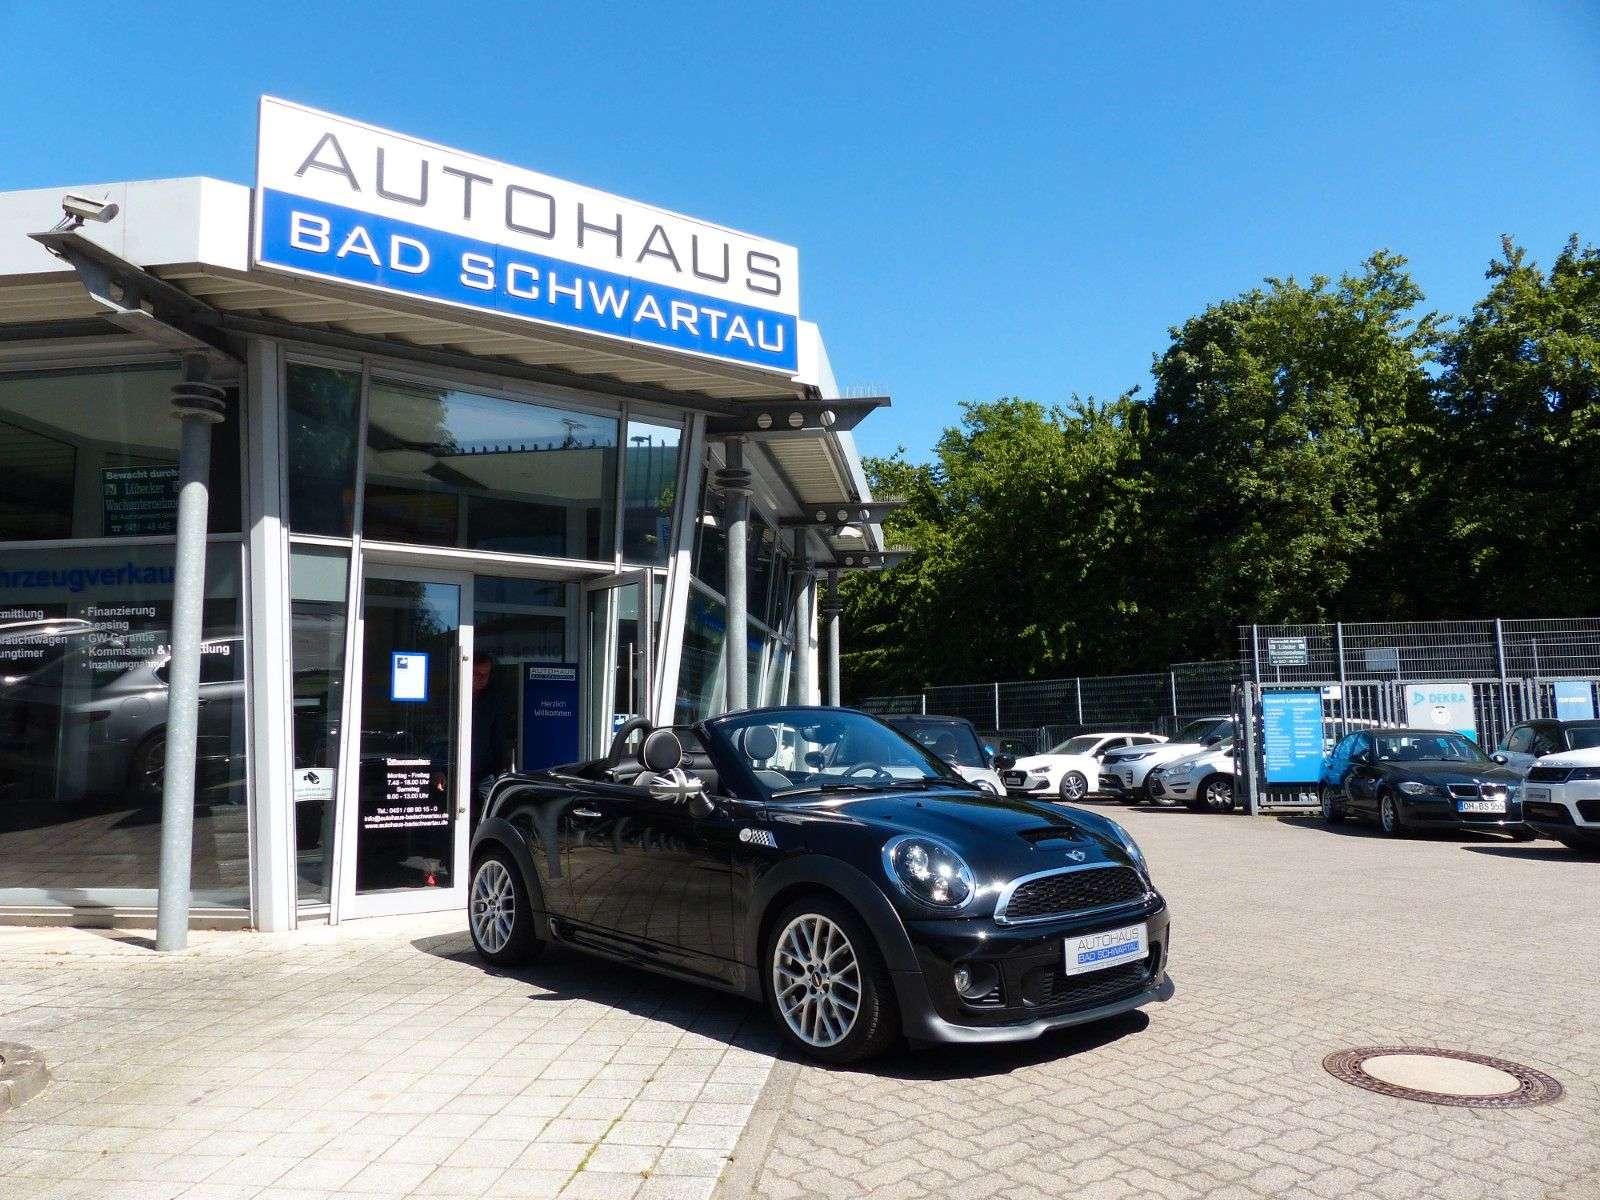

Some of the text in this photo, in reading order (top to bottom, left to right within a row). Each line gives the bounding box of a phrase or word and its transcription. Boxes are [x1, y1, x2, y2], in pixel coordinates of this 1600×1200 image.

[294, 132, 782, 297] AUTOHAUS
[290, 210, 784, 353] BAD SCHWARTAU
[88, 605, 156, 617] Finanzierung
[88, 619, 130, 632] Leasing
[88, 632, 156, 644] GW-Garantie
[88, 646, 155, 657] Kommission
[157, 644, 166, 655] &
[1429, 692, 1466, 703] DEKRA
[1078, 928, 1139, 951] AUTOHAUS
[1079, 952, 1096, 963] BAD
